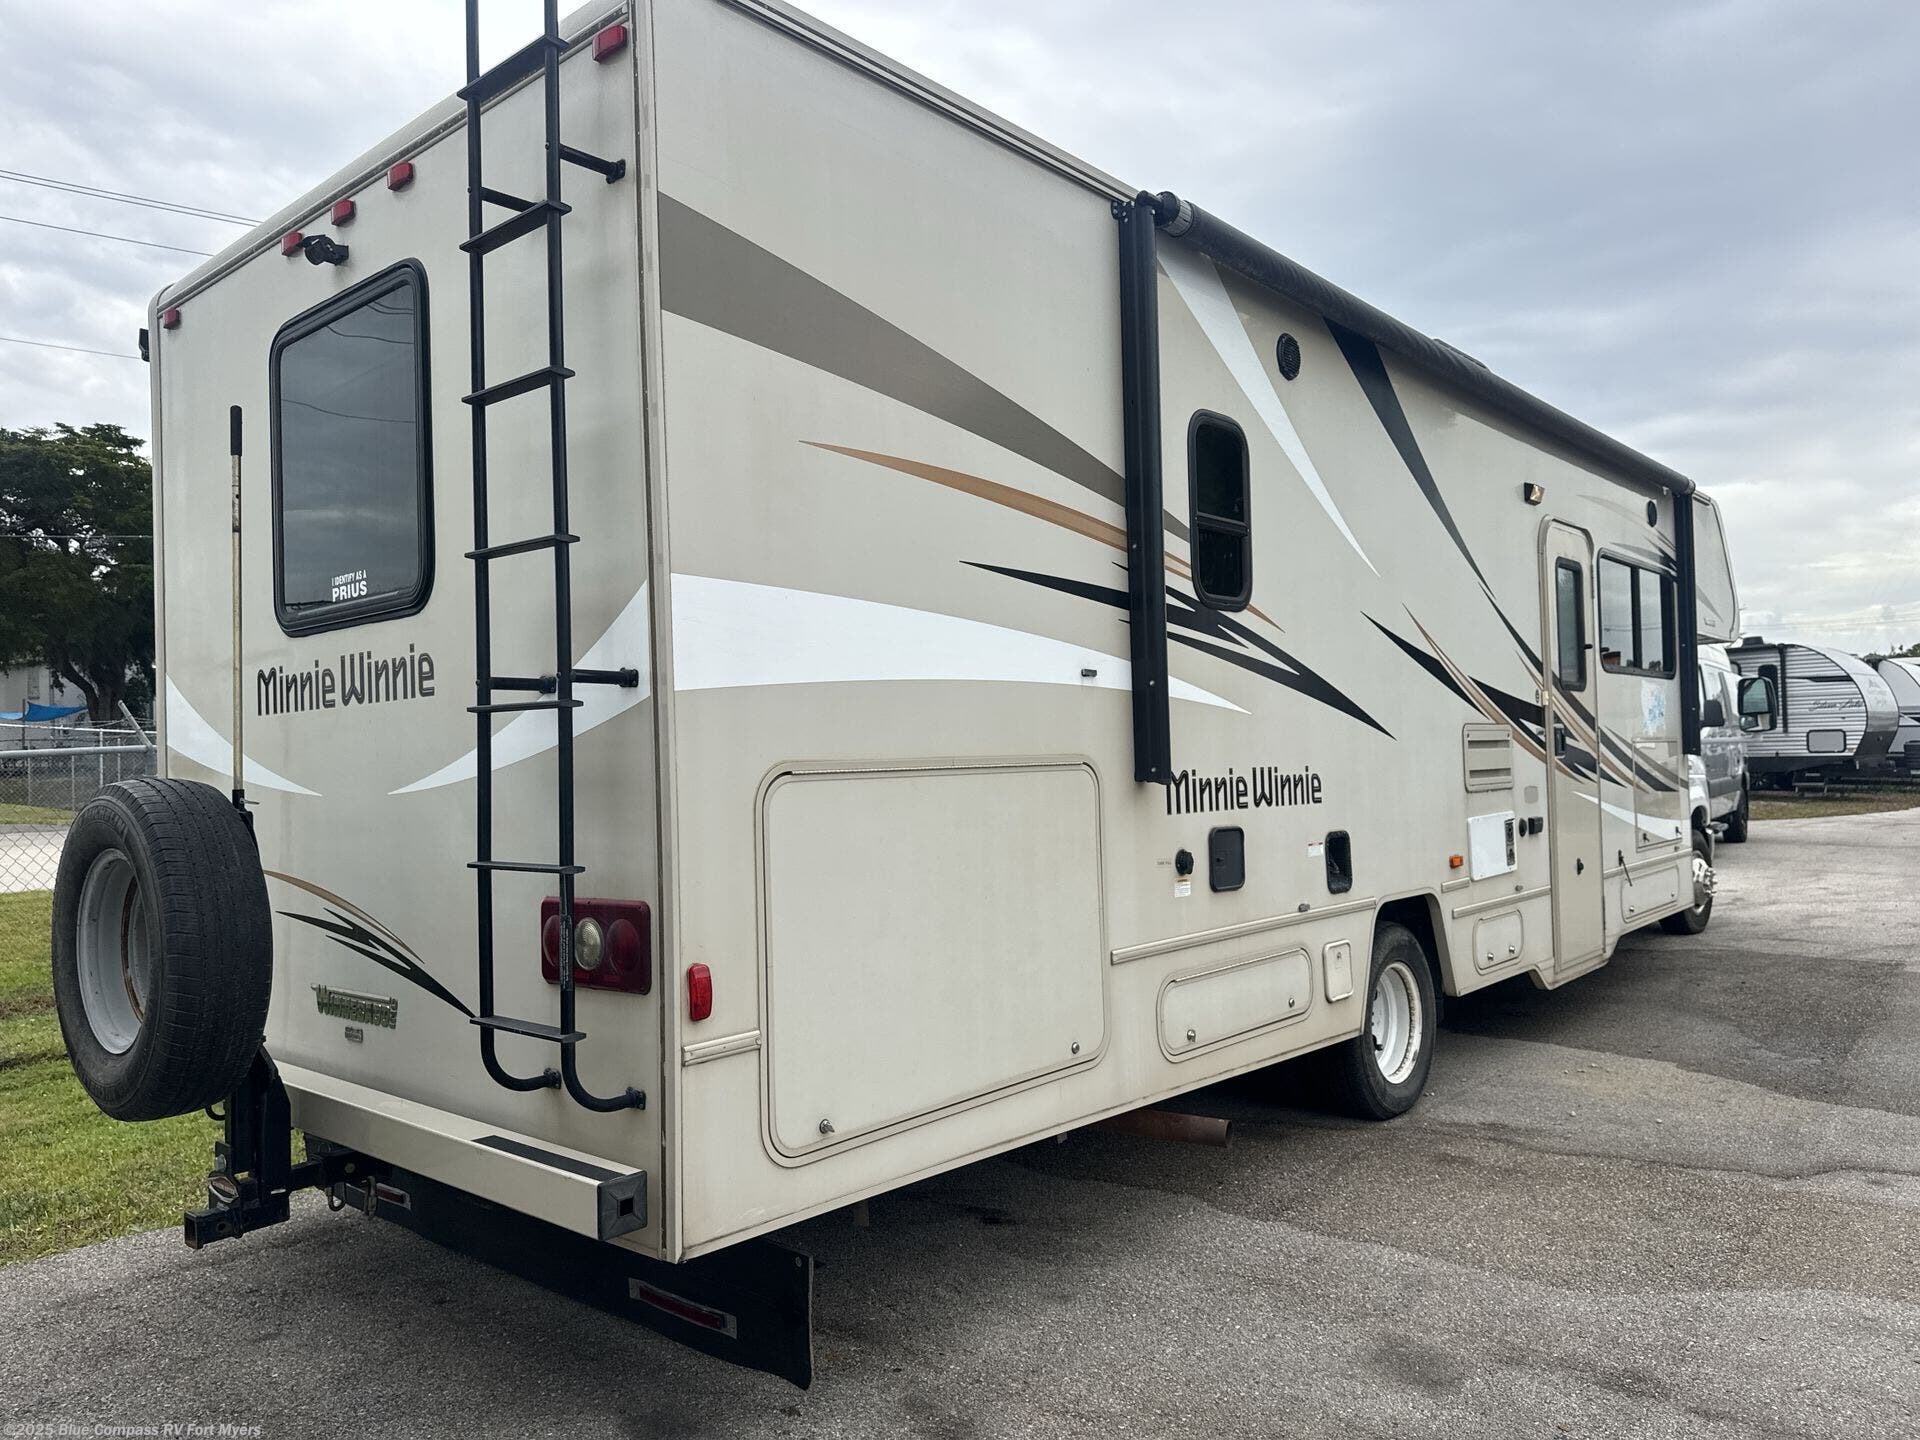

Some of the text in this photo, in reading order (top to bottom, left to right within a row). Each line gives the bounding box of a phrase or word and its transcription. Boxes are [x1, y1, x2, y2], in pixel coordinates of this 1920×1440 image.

[332, 581, 368, 602] PRIUS
[335, 572, 356, 586] IDENTIFY
[356, 570, 363, 581] AS
[363, 569, 367, 579] A
[257, 643, 435, 716] Minnie Winnie
[1166, 766, 1322, 815] Minnie Winnie
